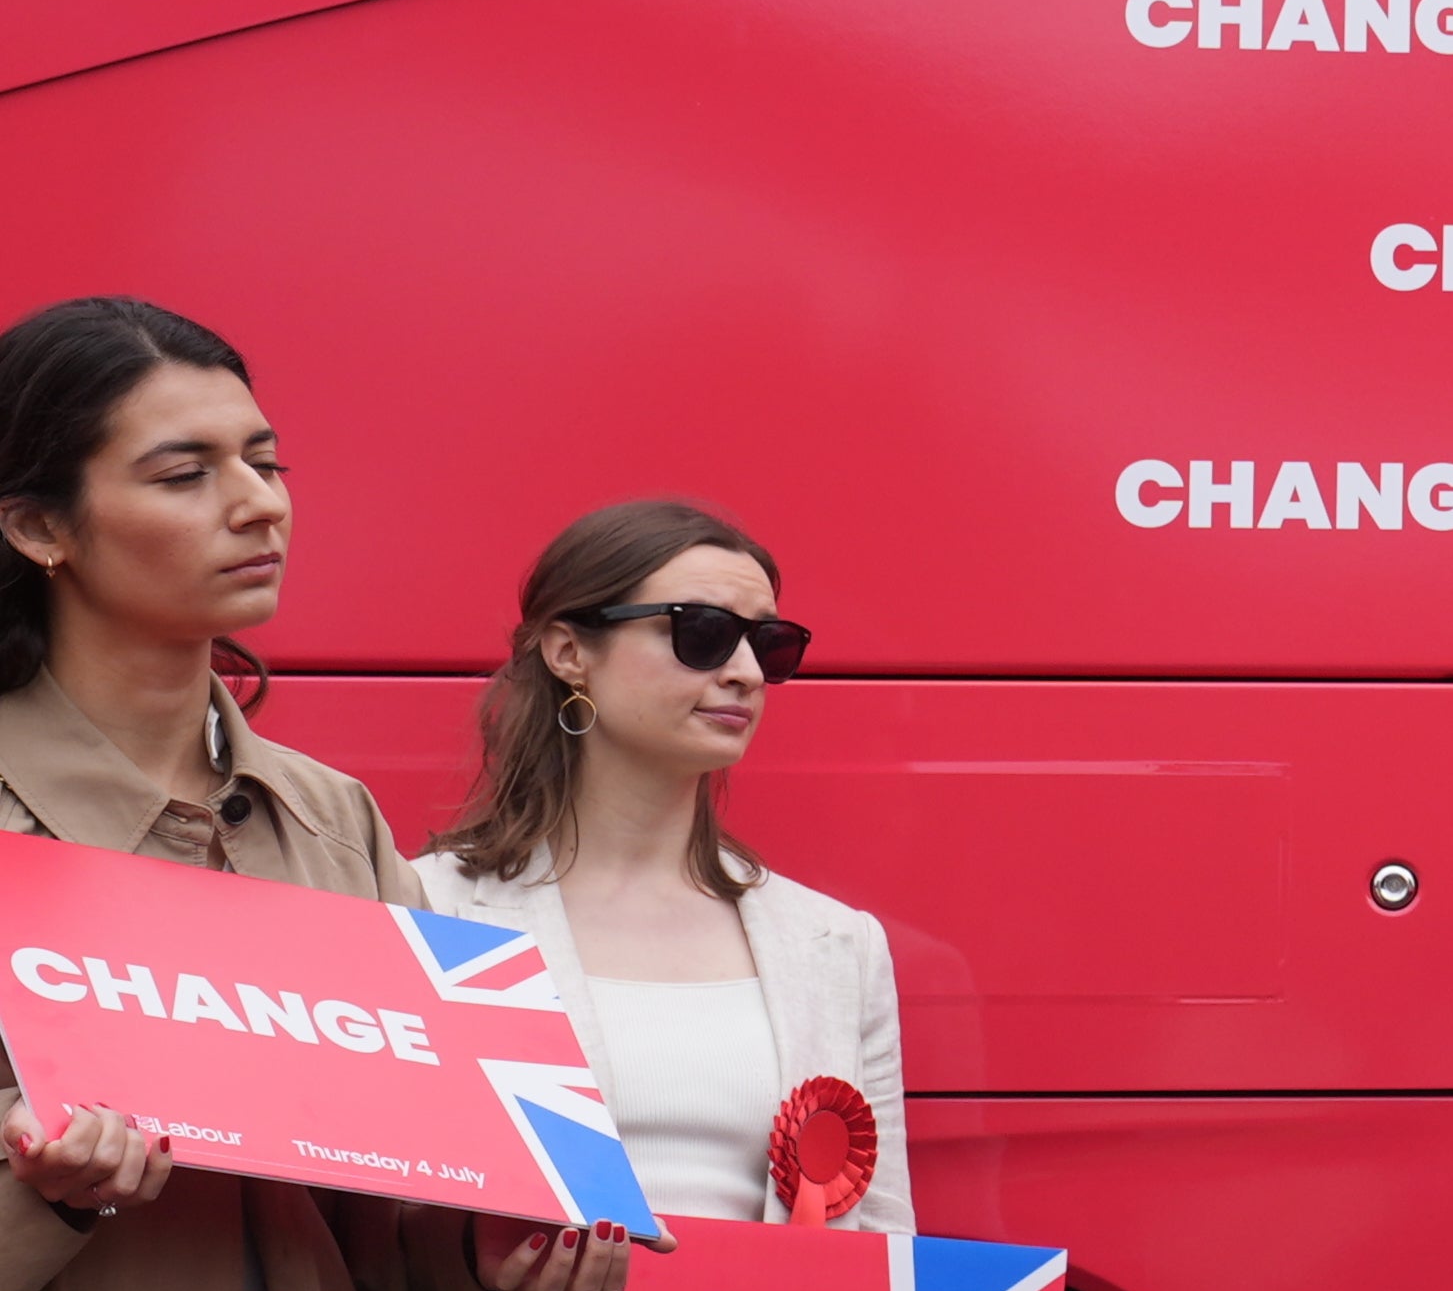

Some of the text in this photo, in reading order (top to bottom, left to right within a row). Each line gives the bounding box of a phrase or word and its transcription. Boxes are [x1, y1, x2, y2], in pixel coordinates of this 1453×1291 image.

[11, 945, 440, 1066] CHANGE
[156, 1118, 242, 1145] Labour
[292, 1140, 409, 1176] Thursday
[417, 1160, 432, 1175] 4
[438, 1164, 484, 1188] July
